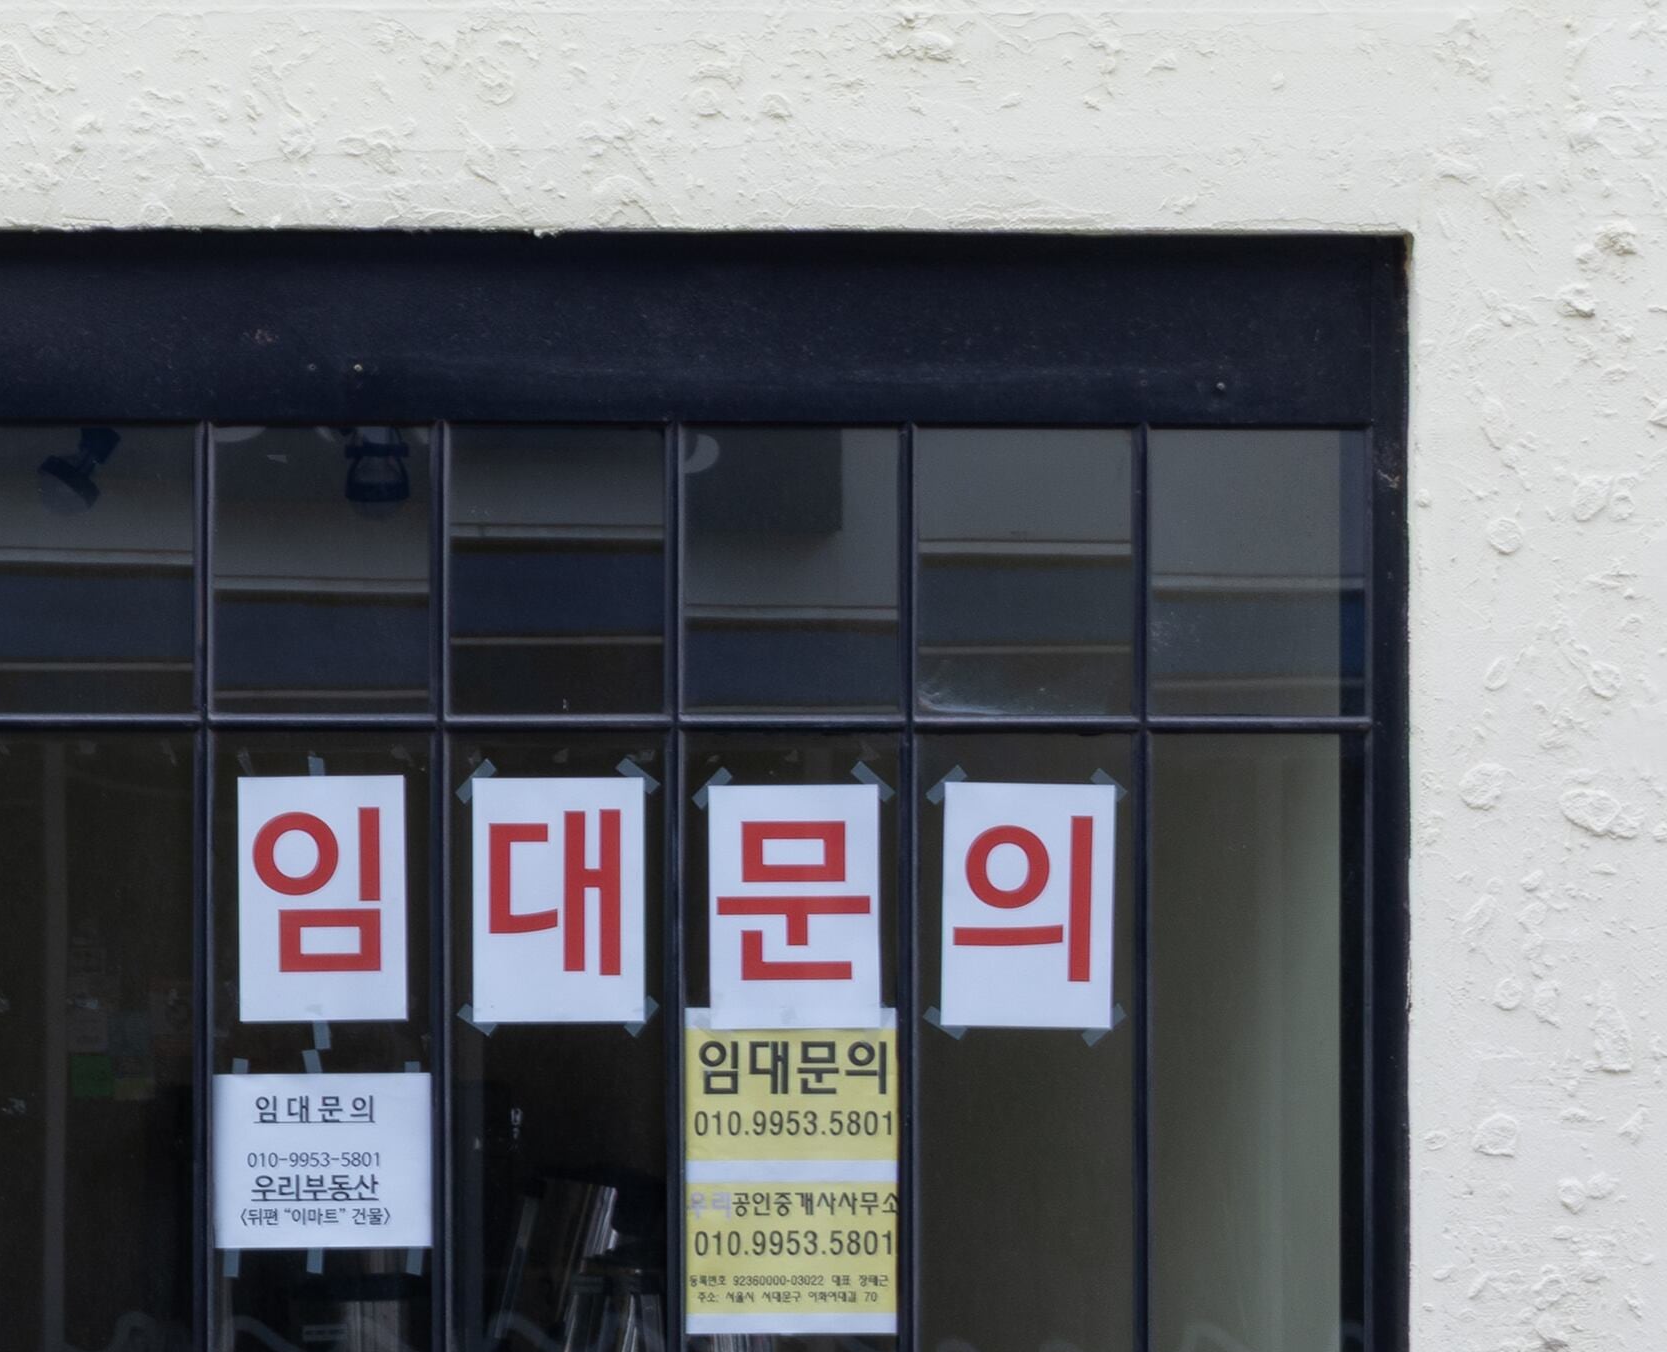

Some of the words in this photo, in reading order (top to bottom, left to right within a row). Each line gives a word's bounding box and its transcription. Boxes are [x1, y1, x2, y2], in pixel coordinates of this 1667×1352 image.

[698, 1040, 887, 1095] 임대문의
[694, 1110, 892, 1136] 010.9953.5801
[247, 1152, 380, 1167] 010-9953-5801
[251, 1174, 379, 1202] 우리부동산
[694, 1230, 892, 1256] 010.9953.5801
[689, 1274, 727, 1287] 등록번호
[831, 1275, 851, 1287] 대표
[725, 1291, 754, 1303] 서울시
[761, 1291, 801, 1303] 서대문구
[863, 1291, 878, 1302] 70
